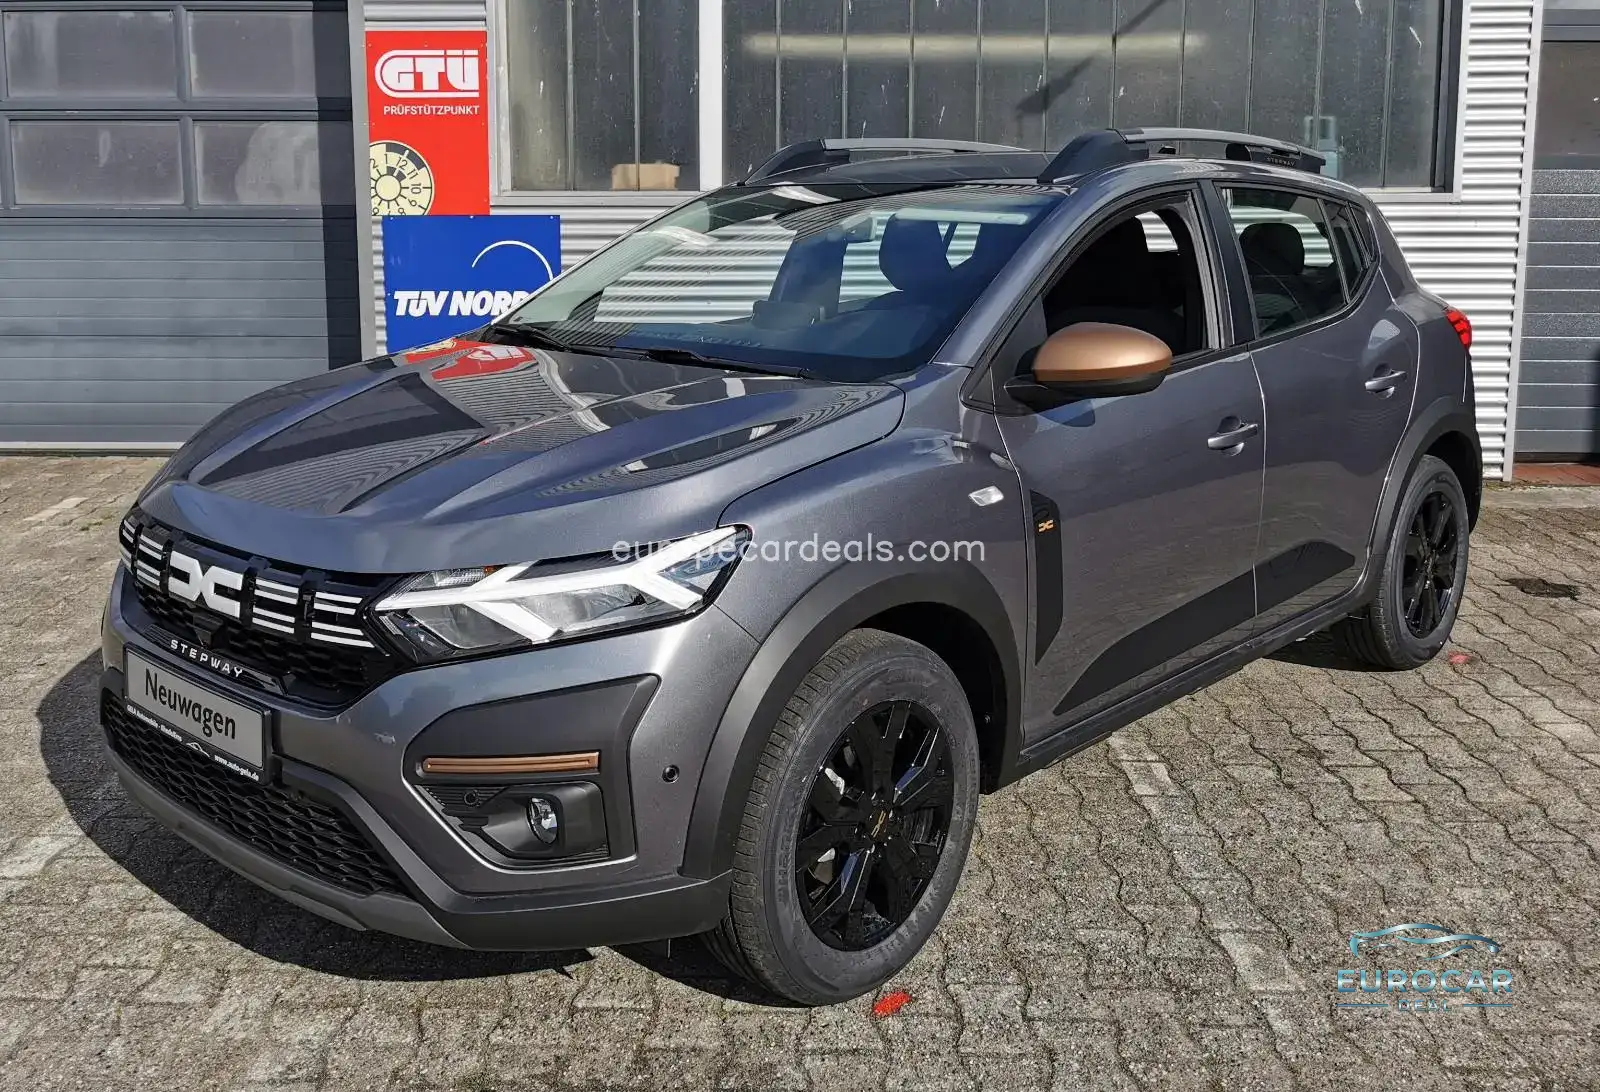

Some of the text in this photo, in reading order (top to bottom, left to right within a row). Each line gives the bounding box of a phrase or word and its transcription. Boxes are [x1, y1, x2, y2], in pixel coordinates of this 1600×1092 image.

[376, 50, 479, 95] GTÜ
[383, 104, 480, 116] PRÜFSTÜTZPUNKT
[396, 156, 408, 170] 12
[411, 182, 422, 194] 10
[393, 290, 449, 317] TÜV
[170, 639, 244, 678] STEPWAY
[145, 668, 236, 739] Neuwagen
